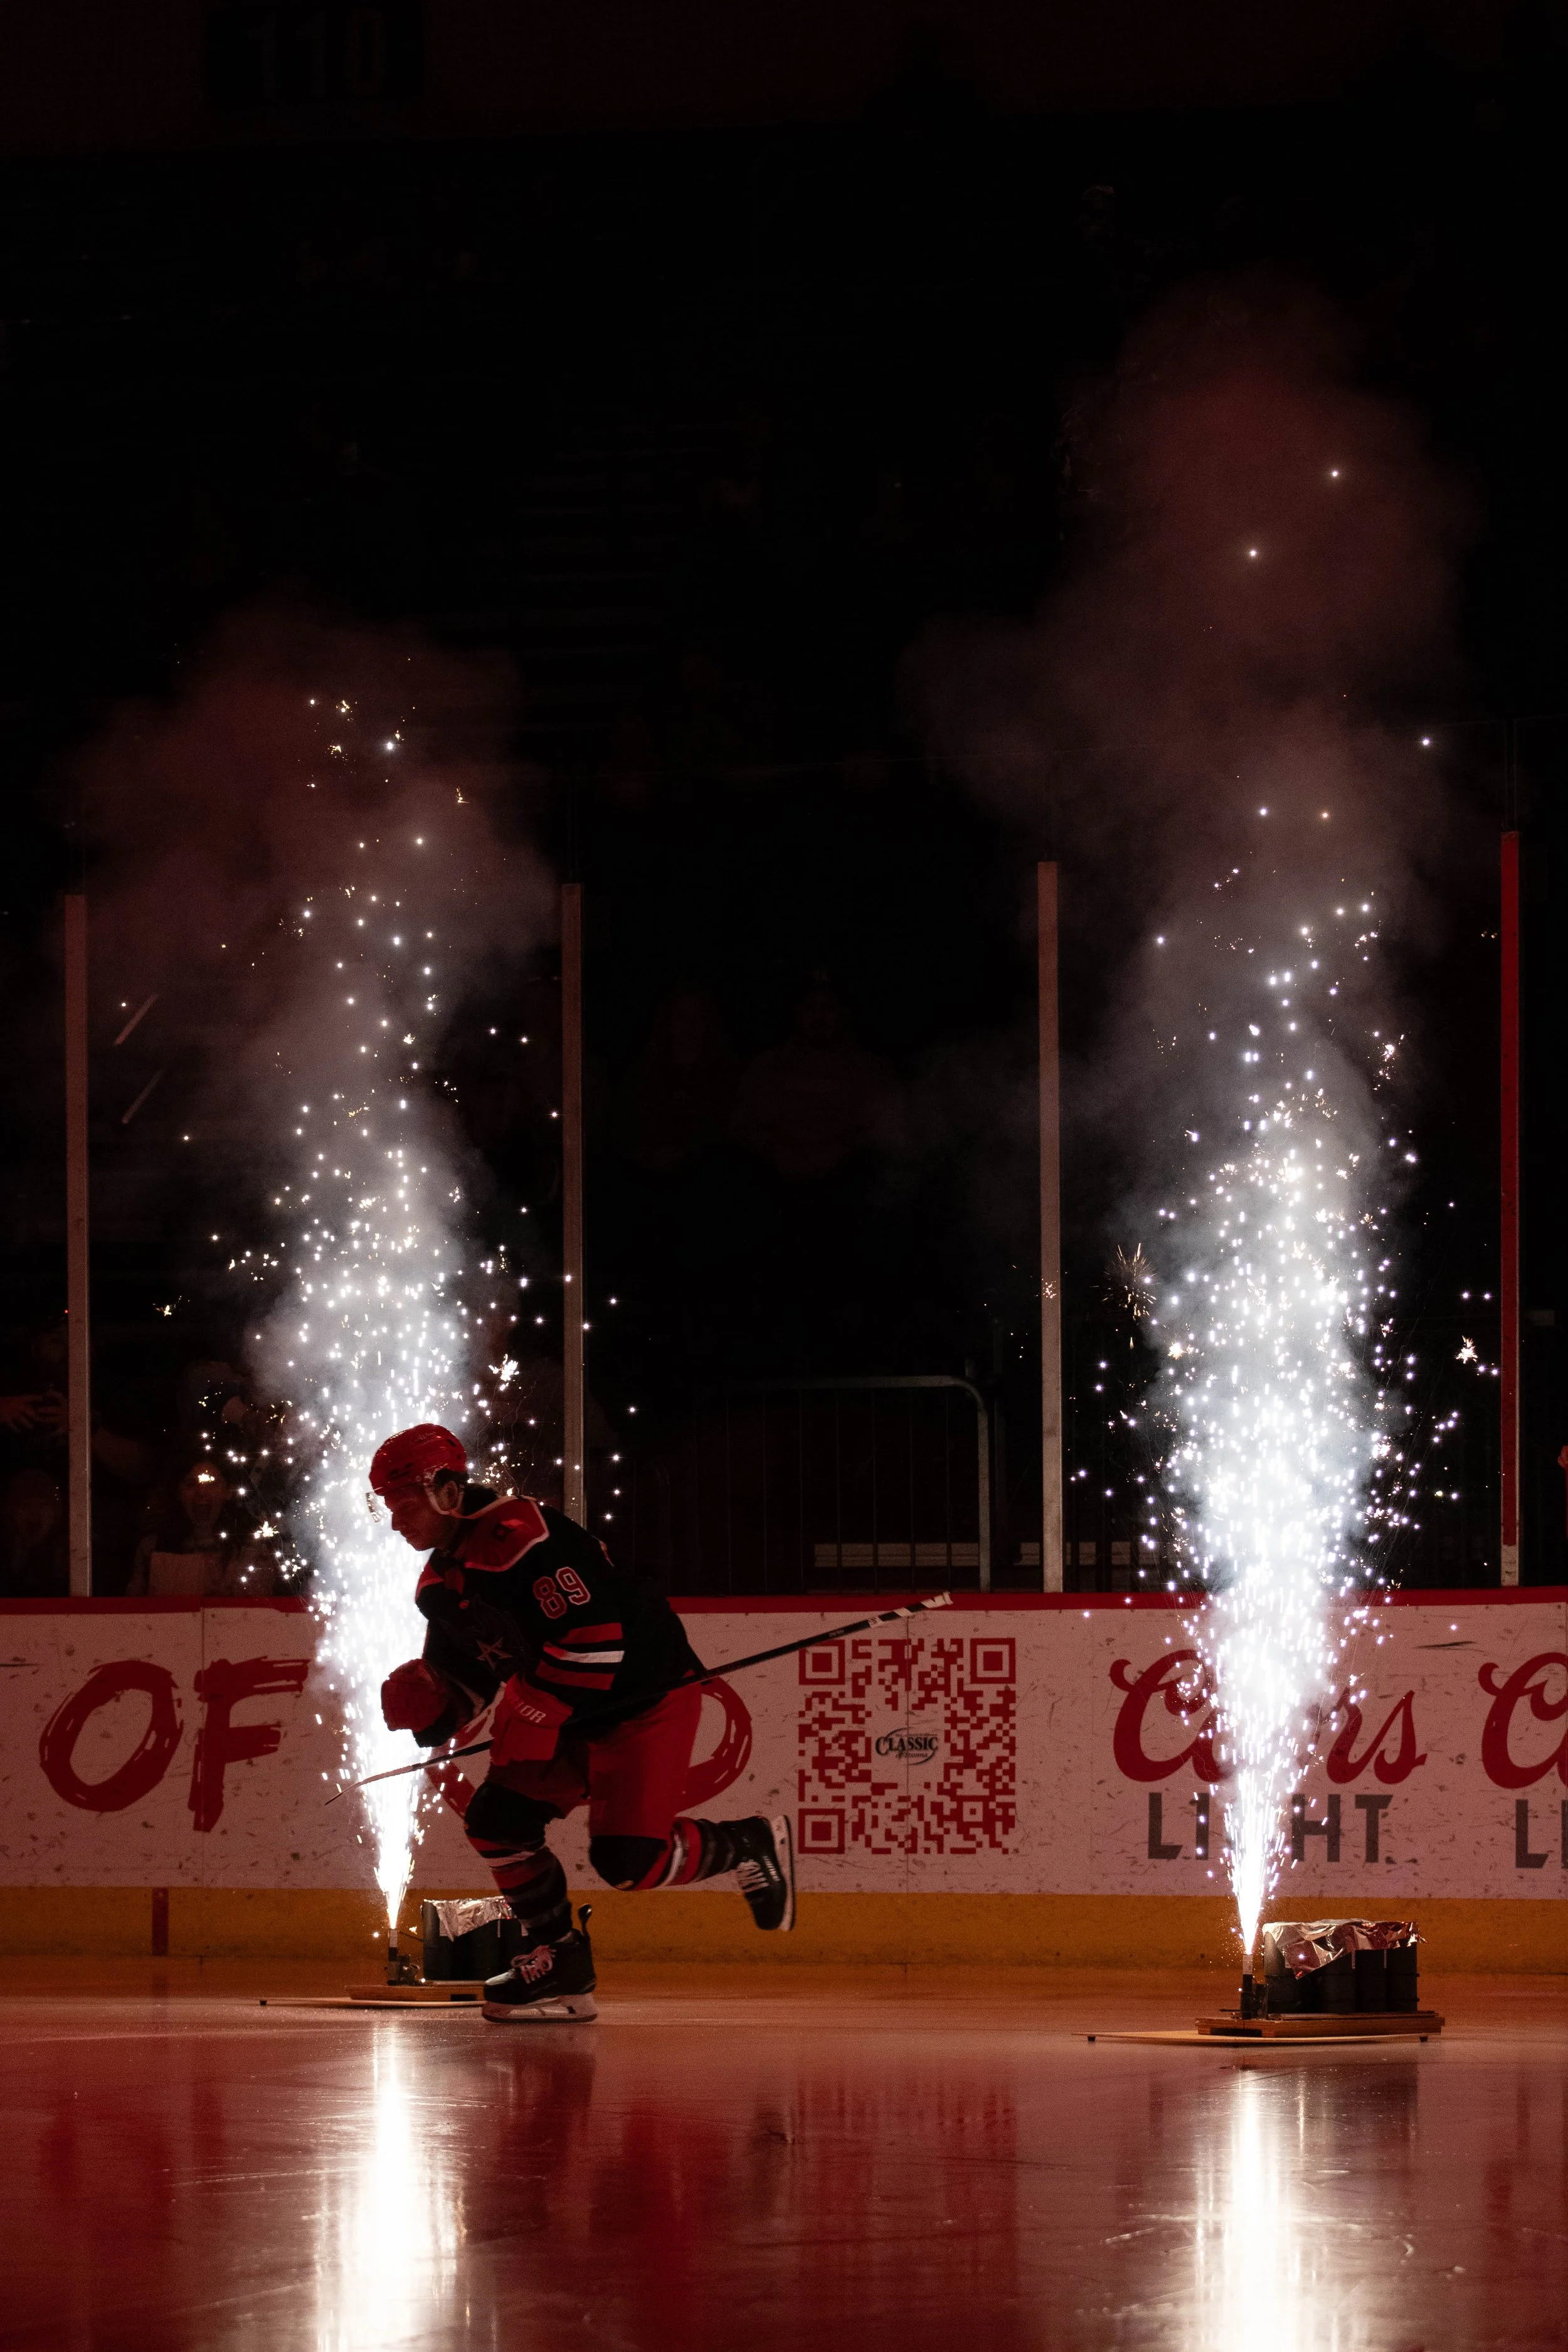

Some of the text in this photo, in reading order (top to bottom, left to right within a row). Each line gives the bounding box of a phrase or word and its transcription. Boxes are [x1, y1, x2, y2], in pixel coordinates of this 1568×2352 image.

[242, 8, 387, 99] 110
[532, 1566, 591, 1619] 89
[39, 1657, 310, 1833] OF
[876, 1736, 938, 1756] CLASSIC
[1110, 1649, 1426, 1784] Crs
[1148, 1792, 1393, 1863] LIHT
